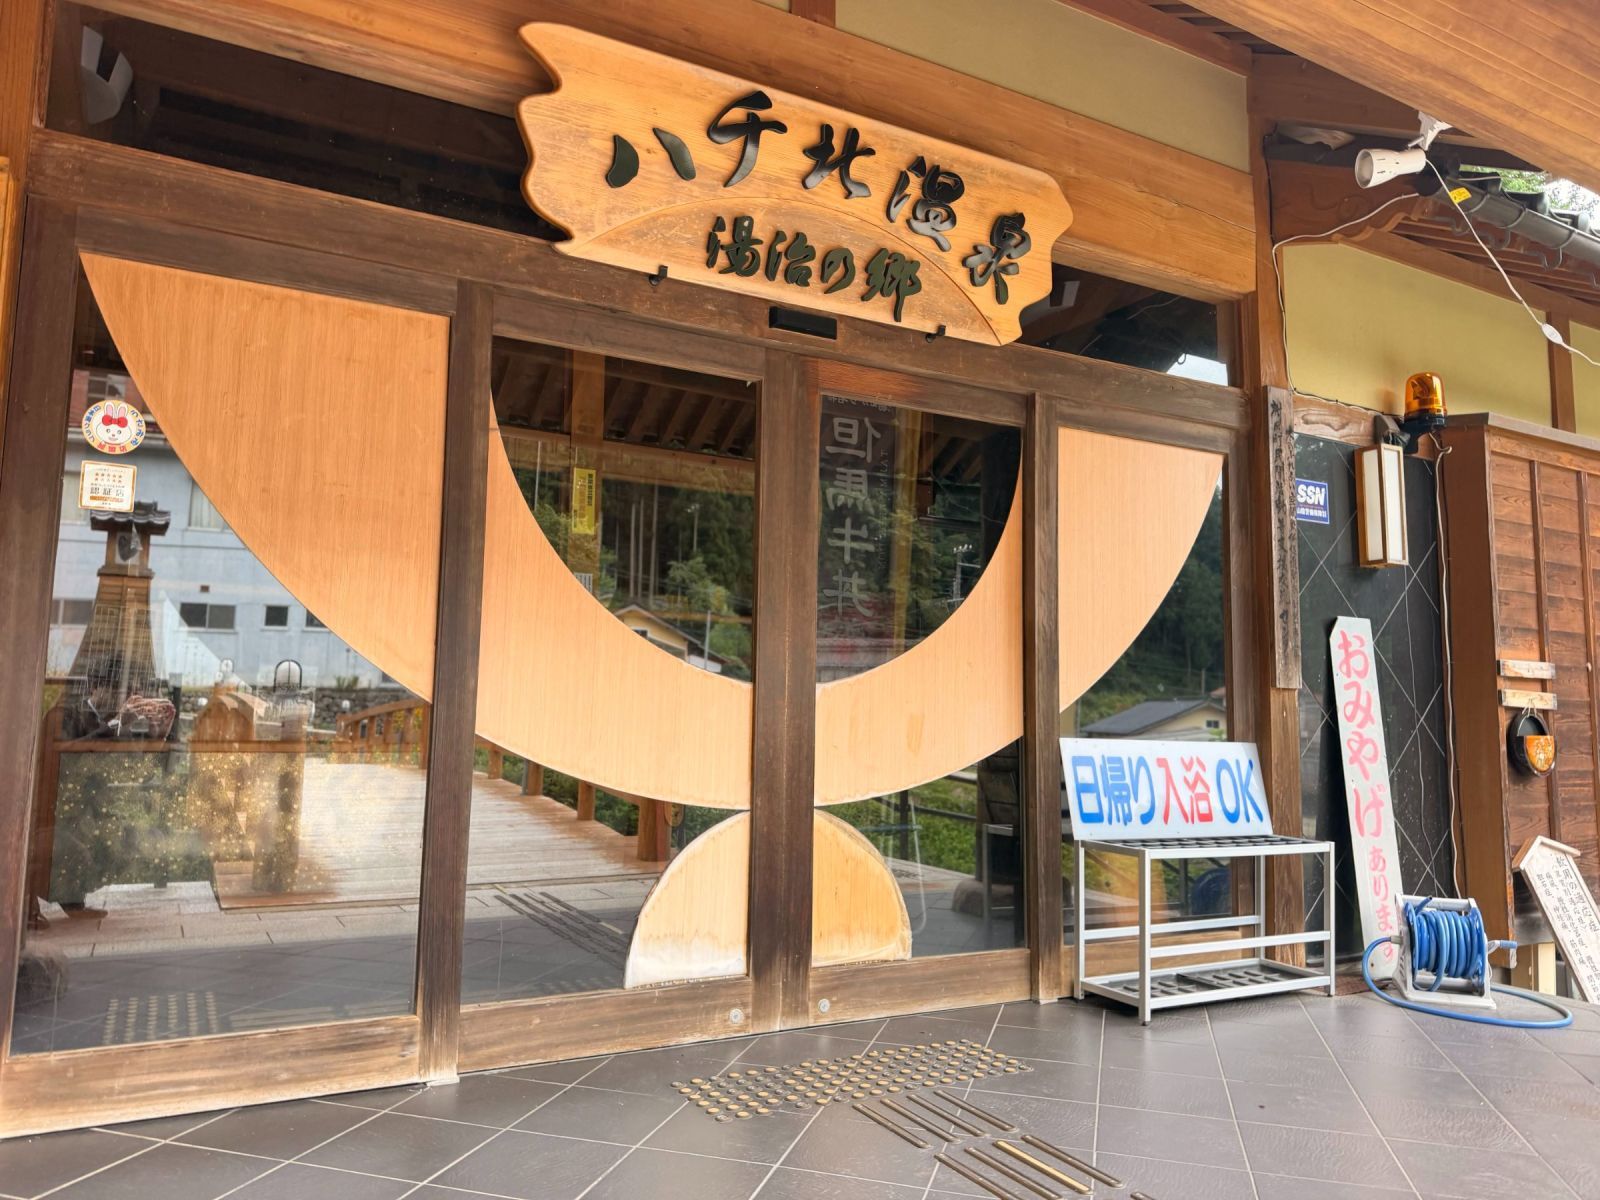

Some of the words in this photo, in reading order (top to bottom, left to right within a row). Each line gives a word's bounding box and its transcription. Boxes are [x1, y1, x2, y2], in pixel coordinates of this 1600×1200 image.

[707, 215, 922, 322] 湯治の郷
[1296, 483, 1326, 506] SSN
